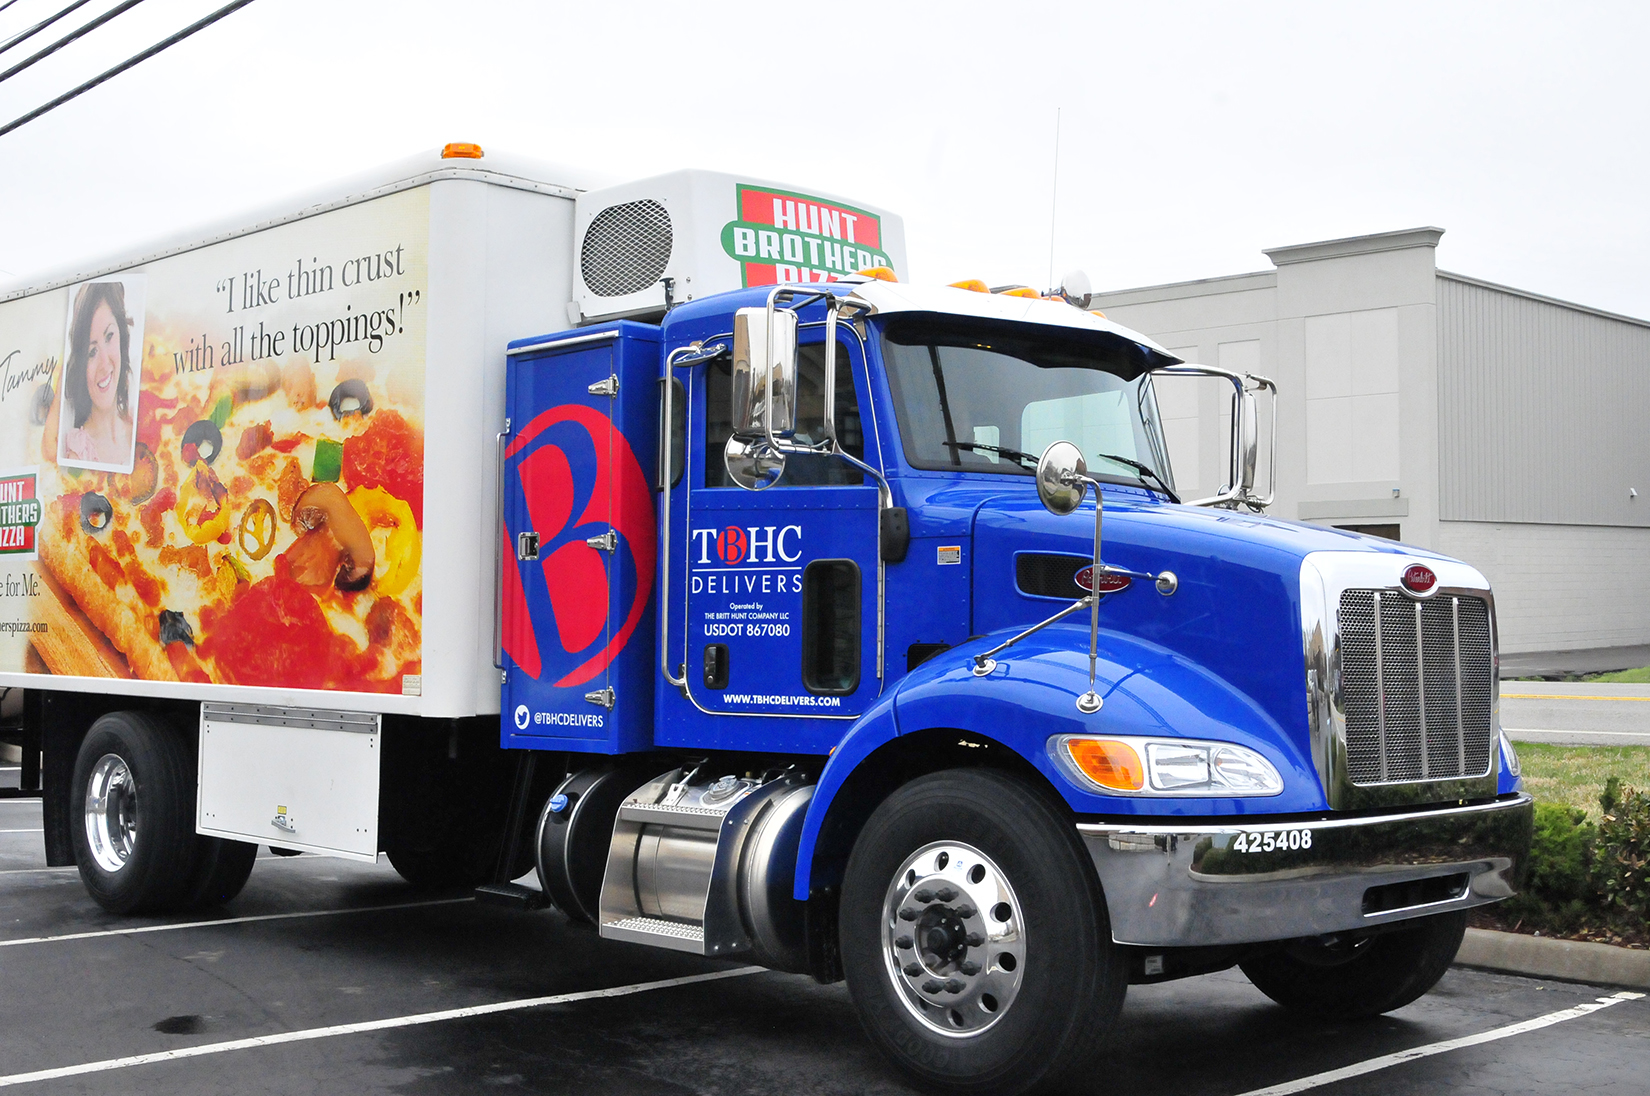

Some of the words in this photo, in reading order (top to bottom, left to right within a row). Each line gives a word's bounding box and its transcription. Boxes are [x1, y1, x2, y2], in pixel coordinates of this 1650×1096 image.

[773, 198, 857, 244] HUNT
[242, 269, 281, 311] like
[287, 257, 334, 300] thin
[342, 243, 405, 287] crust
[173, 334, 214, 376] with
[220, 325, 244, 367] all
[250, 321, 285, 360] the
[0, 349, 58, 402] Tammy
[692, 525, 802, 565] TBHC
[6, 573, 21, 597] for
[691, 574, 803, 594] DELIVERS
[704, 612, 715, 620] THE
[716, 612, 730, 620] BRITT
[731, 612, 747, 620] HUNT
[748, 612, 779, 620] COMPANY
[779, 612, 789, 620] LLC
[729, 602, 755, 611] Operated
[756, 602, 763, 611] by
[704, 624, 743, 637] USDOT
[746, 624, 790, 637] 867080
[723, 694, 840, 707] WWW.TBHCDELIVERS.COM
[534, 712, 604, 728] @TBHCDELIVERS
[1233, 829, 1313, 853] 425408
